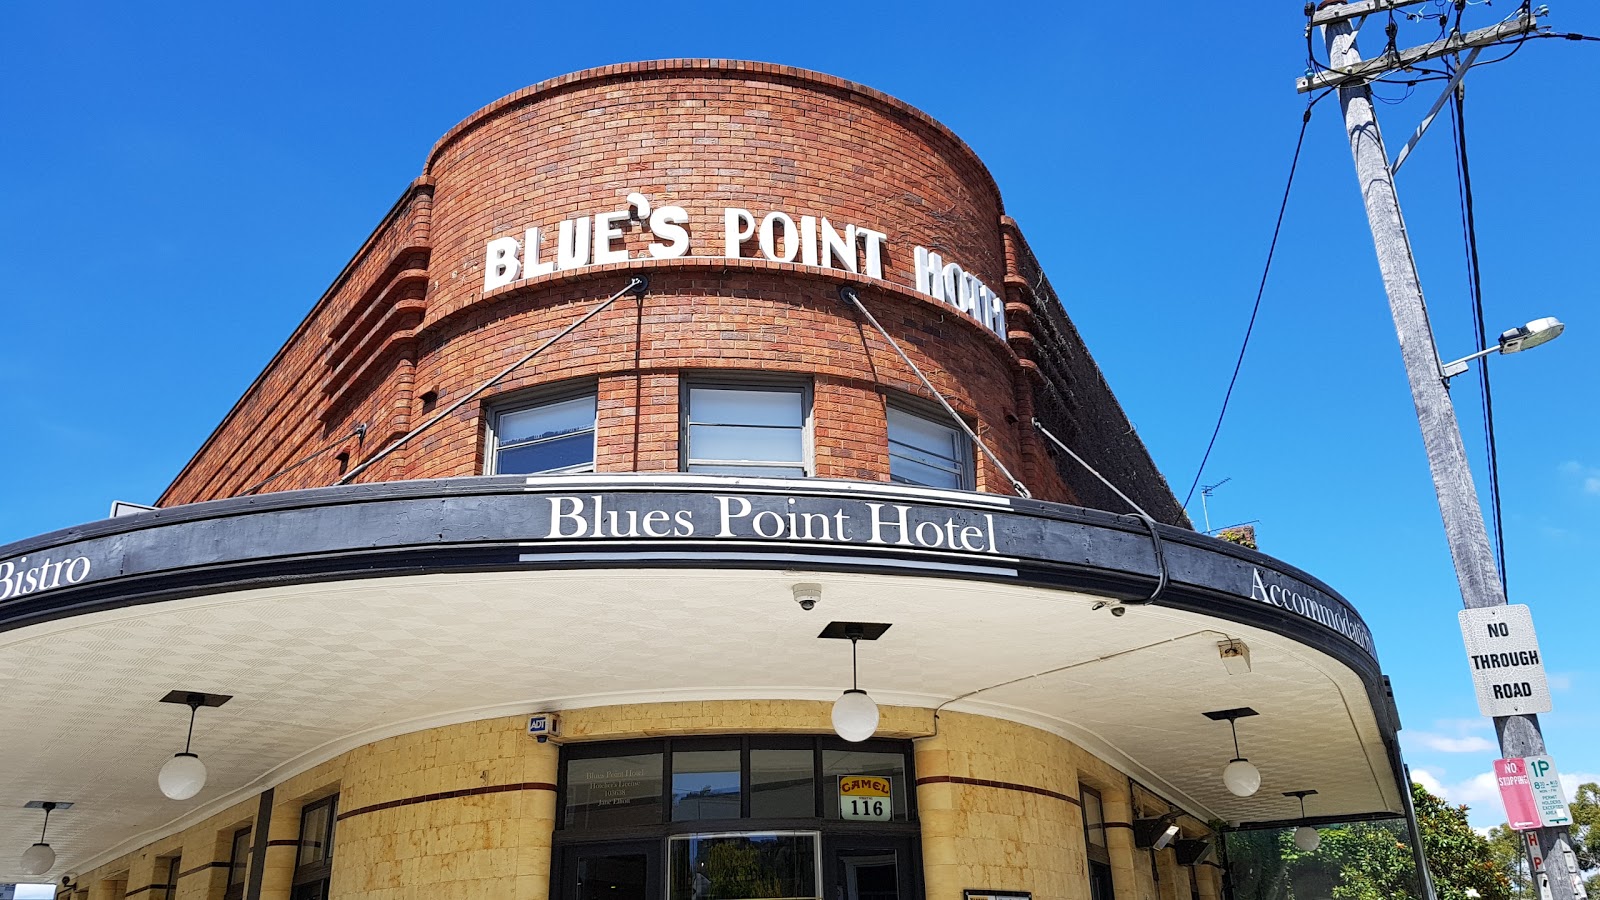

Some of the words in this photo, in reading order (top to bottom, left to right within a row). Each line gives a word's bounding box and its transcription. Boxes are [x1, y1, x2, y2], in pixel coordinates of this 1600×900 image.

[483, 192, 690, 291] BLUE'S
[724, 207, 887, 280] POINT
[545, 494, 695, 540] Blues
[707, 496, 853, 542] Point
[865, 502, 1000, 554] Hotel
[0, 556, 91, 600] Bistro
[1487, 622, 1509, 638] NO
[1471, 650, 1540, 670] THROUGH
[1493, 682, 1532, 700] ROAD
[531, 719, 546, 729] ADT
[1504, 762, 1517, 774] NO
[1531, 760, 1550, 777] 1P
[842, 780, 889, 794] CAMEL
[1498, 775, 1529, 786] STOPPING
[851, 800, 883, 816] 116
[1528, 833, 1538, 846] H
[1533, 857, 1542, 870] P
